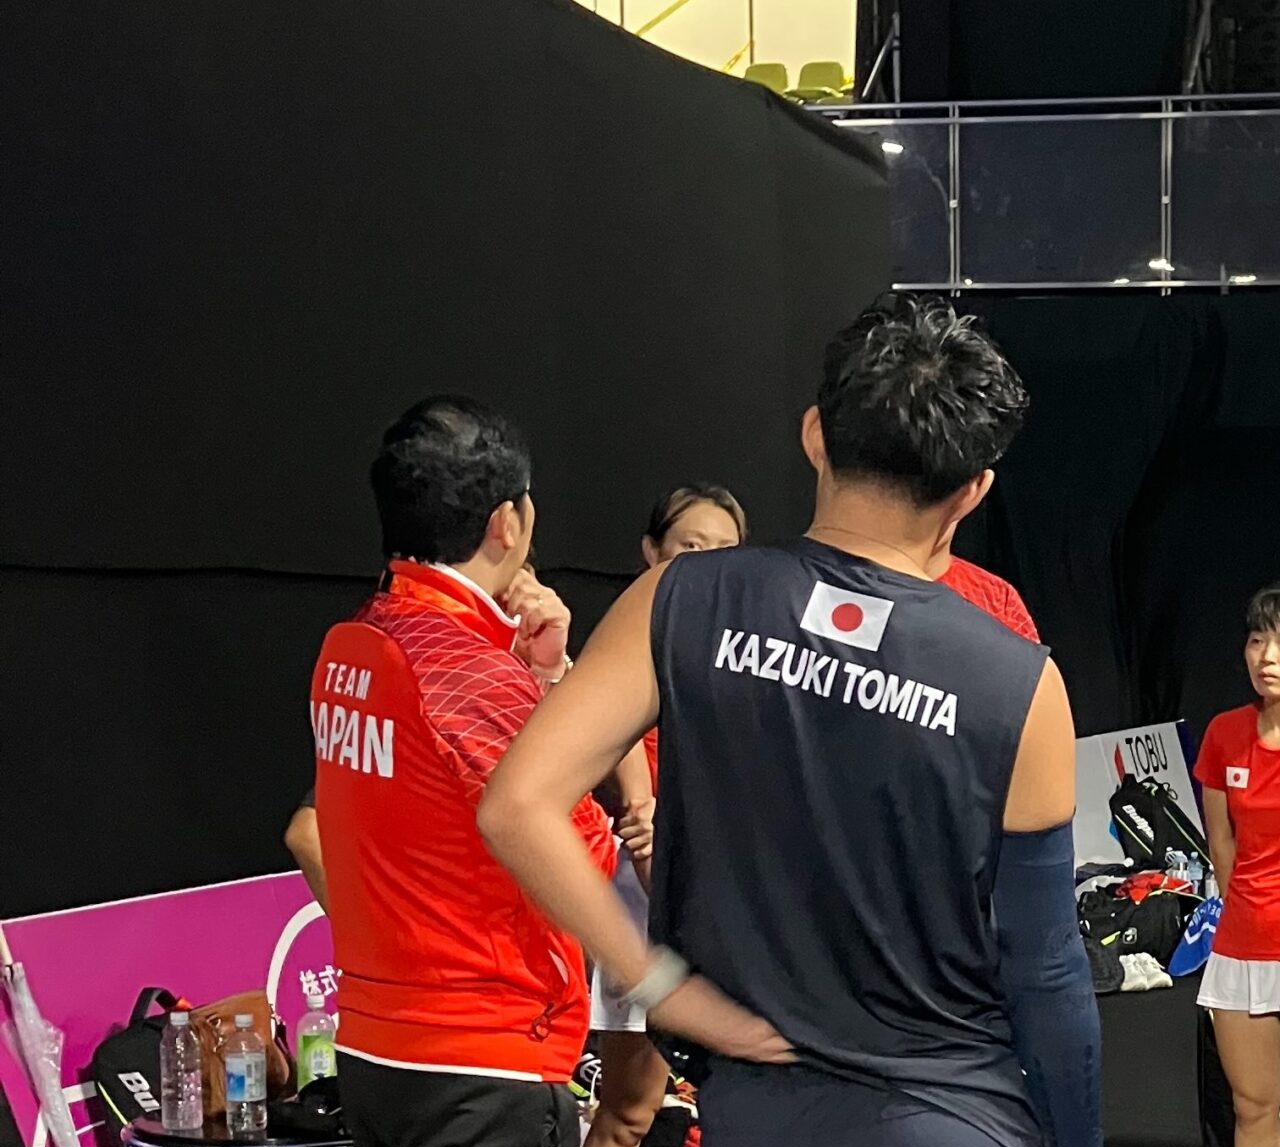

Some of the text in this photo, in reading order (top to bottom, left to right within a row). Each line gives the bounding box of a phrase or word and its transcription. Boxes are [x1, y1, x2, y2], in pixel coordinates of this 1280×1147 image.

[325, 662, 371, 700] TEAM
[715, 628, 958, 736] KAZUKI TOMITA
[1125, 732, 1168, 777] TOBU
[299, 964, 343, 997] 株式
